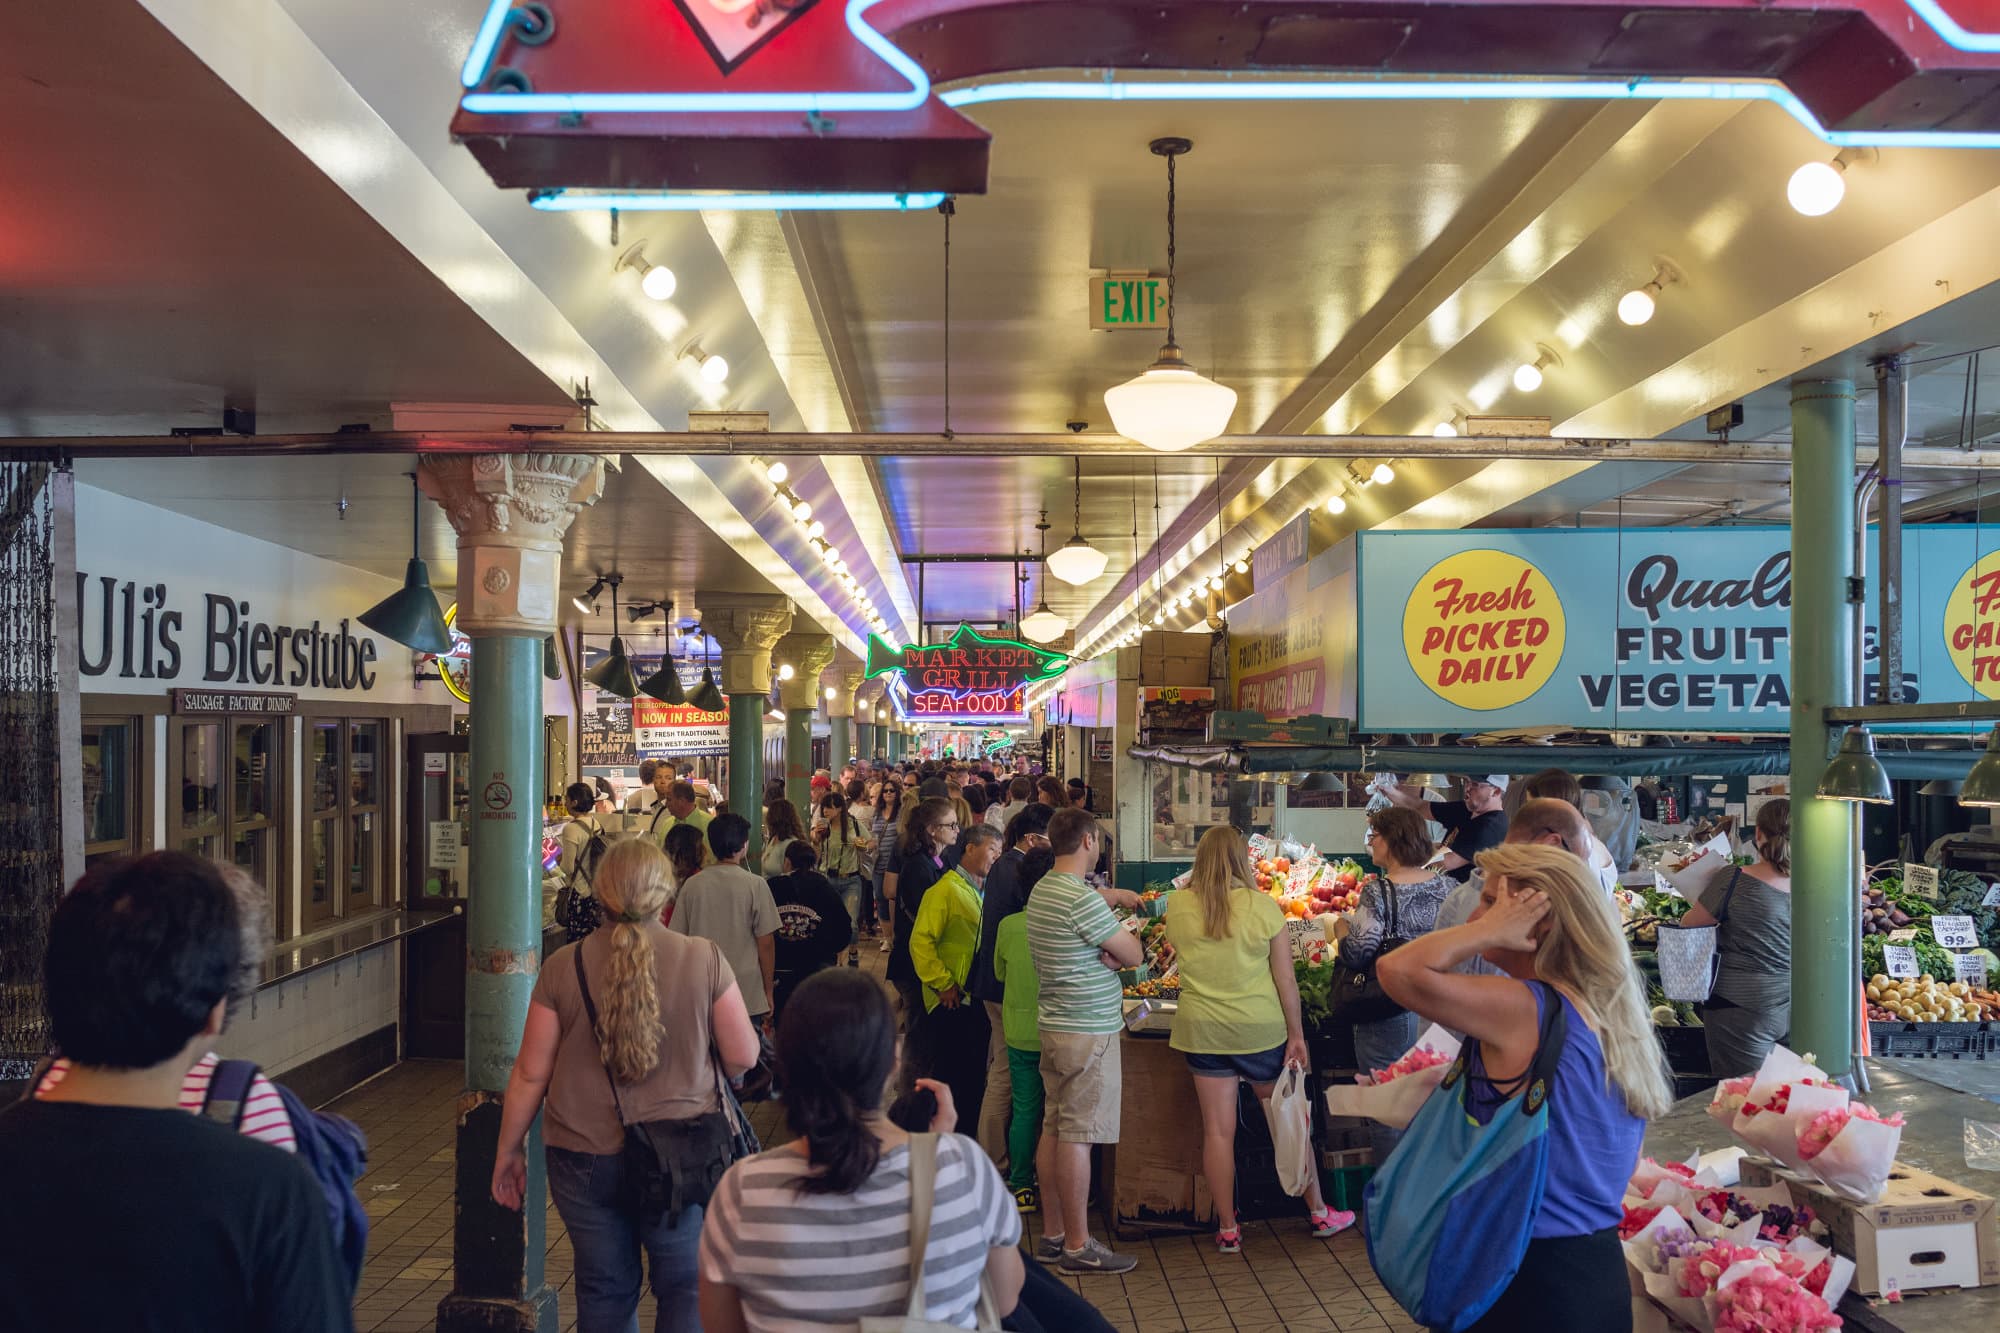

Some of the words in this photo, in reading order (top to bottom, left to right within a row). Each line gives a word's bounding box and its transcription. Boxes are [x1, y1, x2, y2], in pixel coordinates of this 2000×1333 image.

[1104, 281, 1159, 323] EXIT
[1433, 569, 1536, 621] Fresh
[76, 571, 182, 680] Uli's
[202, 593, 377, 690] Bierstube
[1421, 617, 1550, 656] PICKED
[1615, 626, 1791, 663] FRUIT
[904, 648, 1036, 668] MARKET
[922, 669, 1017, 689] GRILL
[1437, 652, 1537, 687] DAILY
[267, 697, 292, 712] DINING
[914, 694, 1007, 713] SEAFOOD
[642, 712, 667, 724] NOW
[671, 712, 683, 723] IN
[686, 711, 729, 723] SEASON
[677, 729, 720, 737] TRADITIONAL
[493, 771, 504, 780] NO
[480, 811, 517, 820] SMOKING
[1944, 936, 1965, 945] 99
